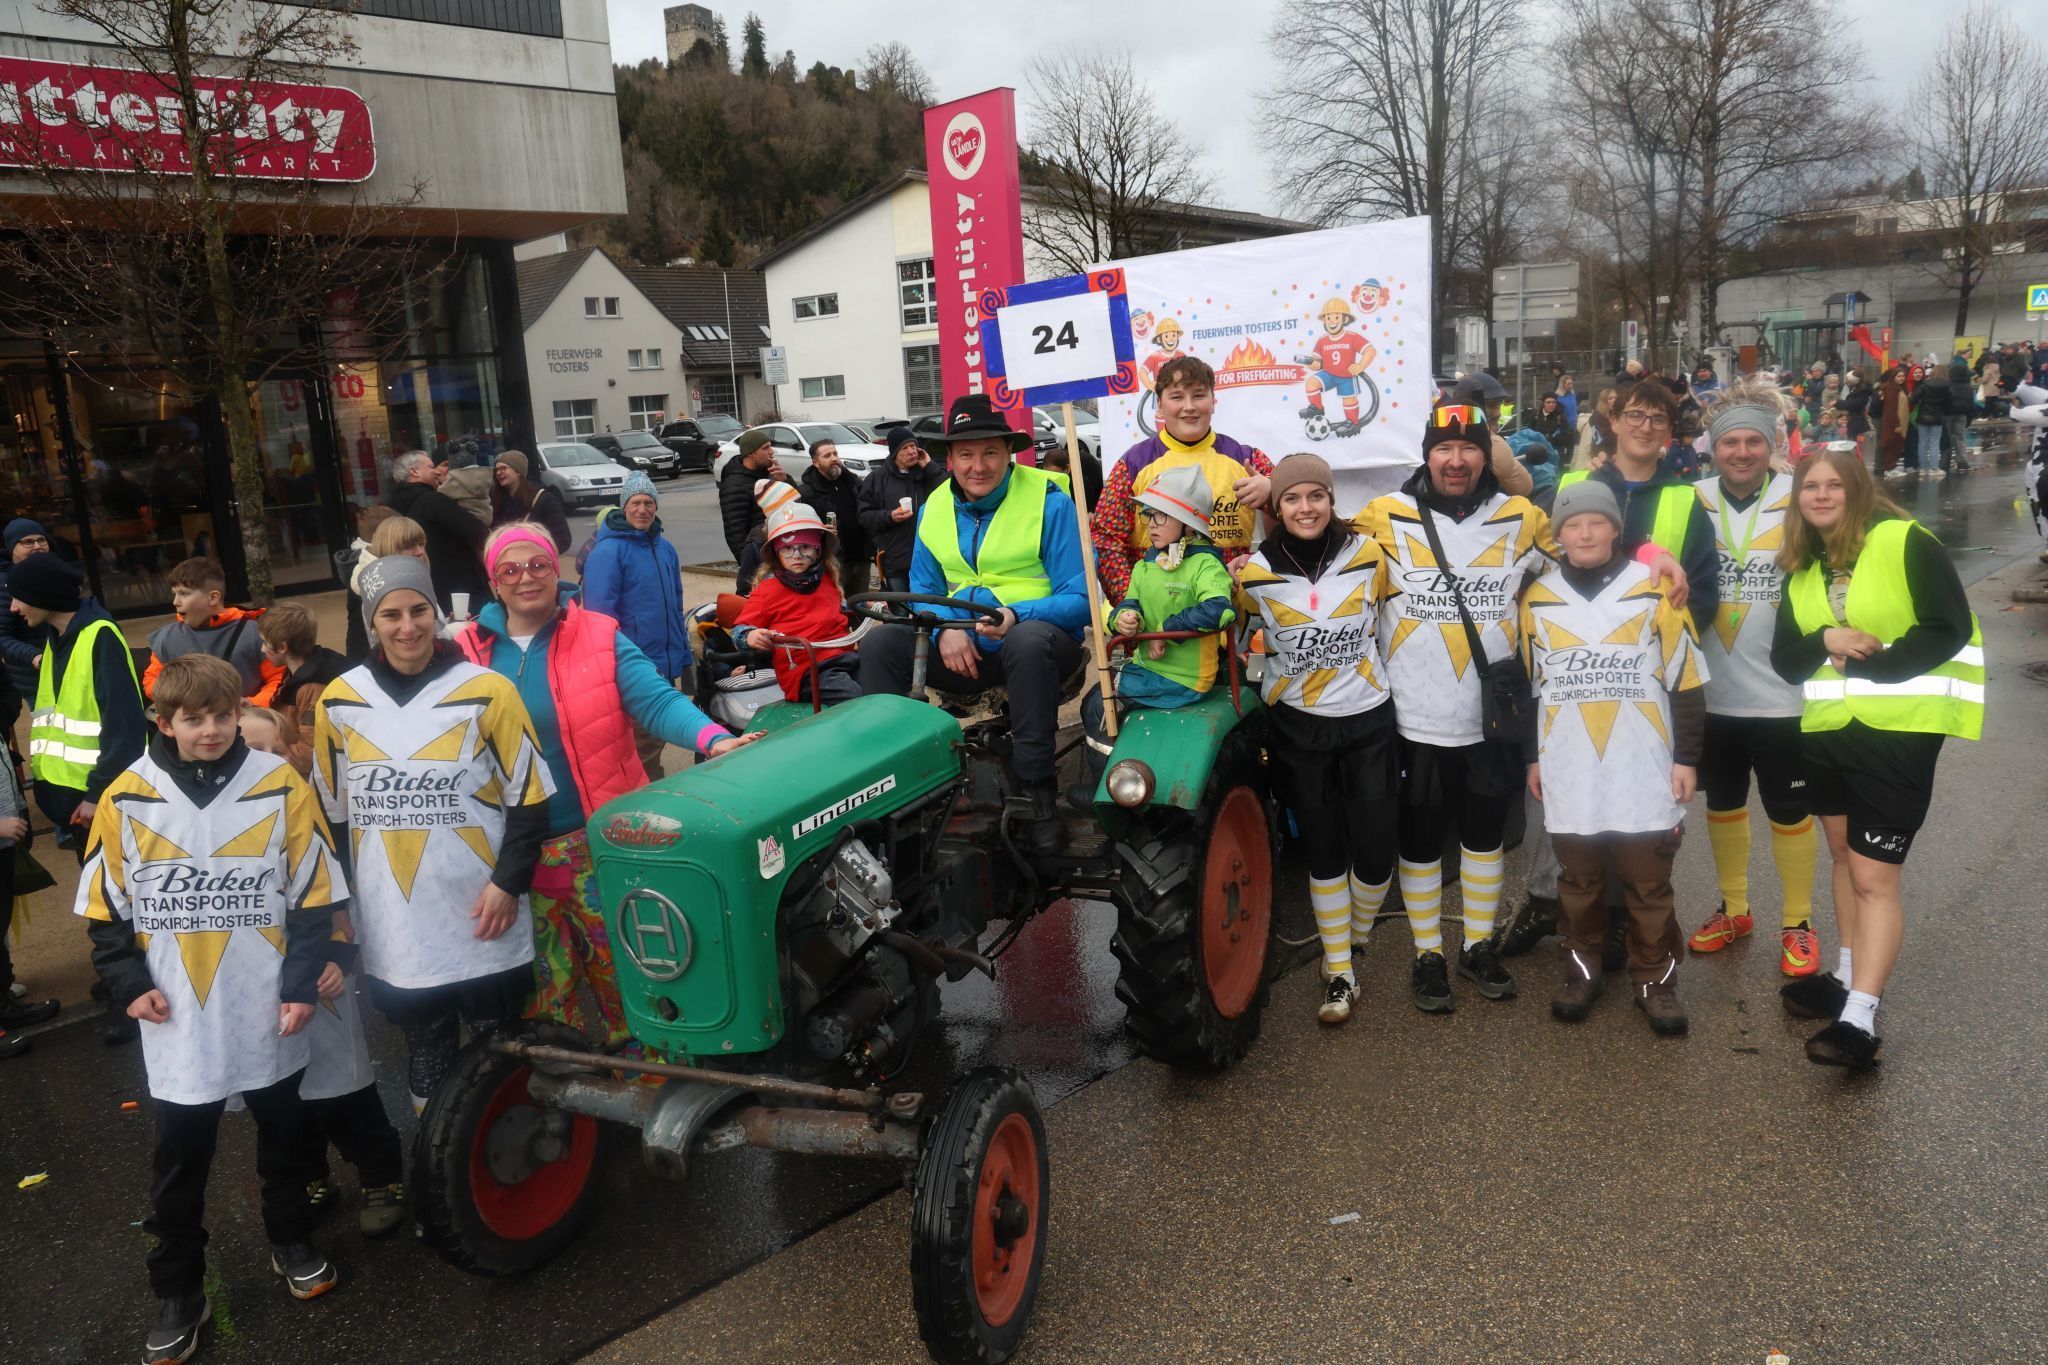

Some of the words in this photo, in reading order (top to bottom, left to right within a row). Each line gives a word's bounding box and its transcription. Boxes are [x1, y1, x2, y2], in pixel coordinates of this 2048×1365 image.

[956, 192, 983, 395] utterlüty
[1032, 320, 1079, 354] 24
[1192, 325, 1242, 340] FEUERWEHR
[1244, 320, 1282, 334] TOSTERS
[1284, 319, 1298, 329] IST
[546, 348, 603, 360] FEUERWEHR
[1332, 351, 1340, 365] 9
[548, 361, 589, 373] TOSTERS
[1219, 373, 1235, 384] FOR
[1236, 369, 1297, 382] FIREFIGHTING
[1212, 495, 1241, 513] kel
[1403, 570, 1511, 593] Bickel
[1275, 618, 1368, 649] Bickel
[1285, 641, 1361, 664] TRANSPORTE
[1545, 648, 1646, 671] Bickel
[1554, 671, 1641, 688] TRANSPORTE
[1550, 687, 1646, 702] FELDKIRCH-TOSERS
[347, 764, 468, 792] Bickel
[352, 794, 460, 809] TRANSPORTE
[798, 778, 893, 837] Lindner
[132, 863, 275, 893] Bickel
[140, 894, 265, 912] TRANSPORTE
